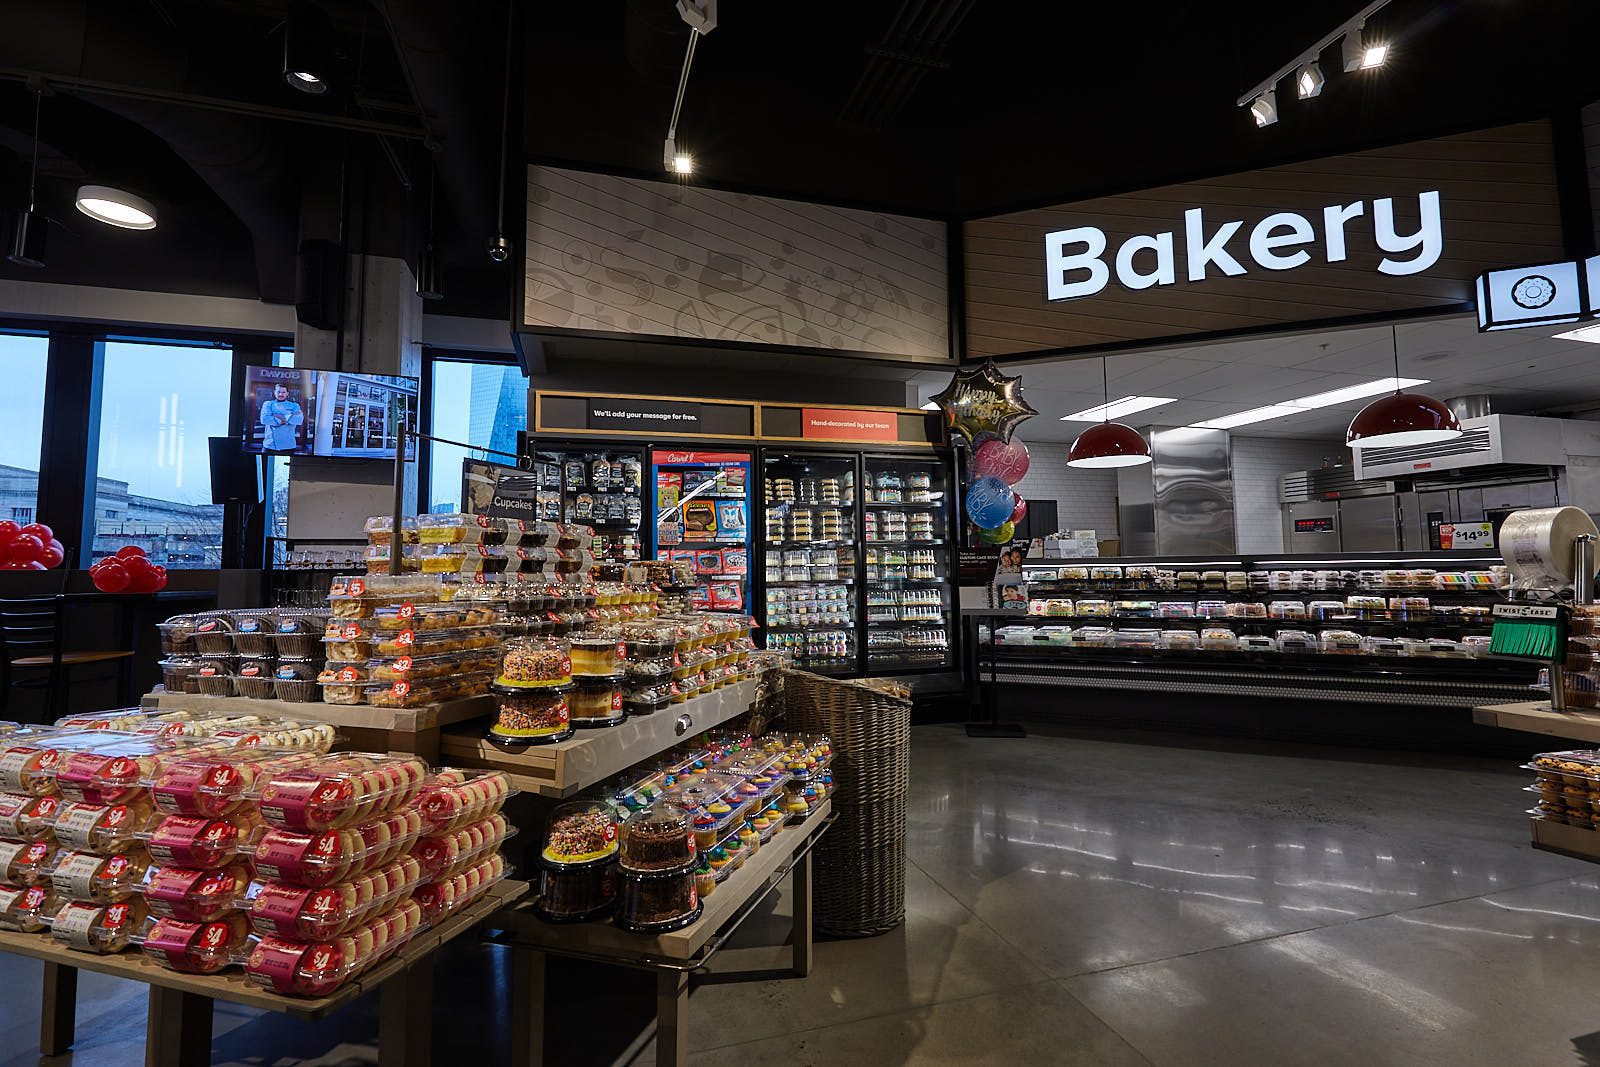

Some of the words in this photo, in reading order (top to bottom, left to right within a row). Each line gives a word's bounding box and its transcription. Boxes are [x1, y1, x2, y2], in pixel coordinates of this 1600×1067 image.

[1045, 190, 1443, 301] Bakery
[594, 409, 611, 417] We'll
[626, 411, 641, 419] your
[683, 413, 697, 421] free.
[811, 419, 856, 427] Hand-decorated
[857, 421, 865, 429] by
[493, 497, 532, 511] Cupcakes
[1498, 607, 1520, 615] TWIST
[39, 754, 55, 768] $4
[110, 761, 125, 776] $4
[213, 769, 230, 785] $4
[320, 788, 339, 801] $4
[38, 800, 53, 815] $4
[108, 809, 123, 826] $4
[605, 825, 615, 839] $5
[318, 836, 335, 854] $4
[25, 891, 42, 908] $4
[313, 895, 331, 912] $4
[107, 906, 124, 924] $4
[207, 926, 223, 946] $4
[313, 951, 331, 970] $4
